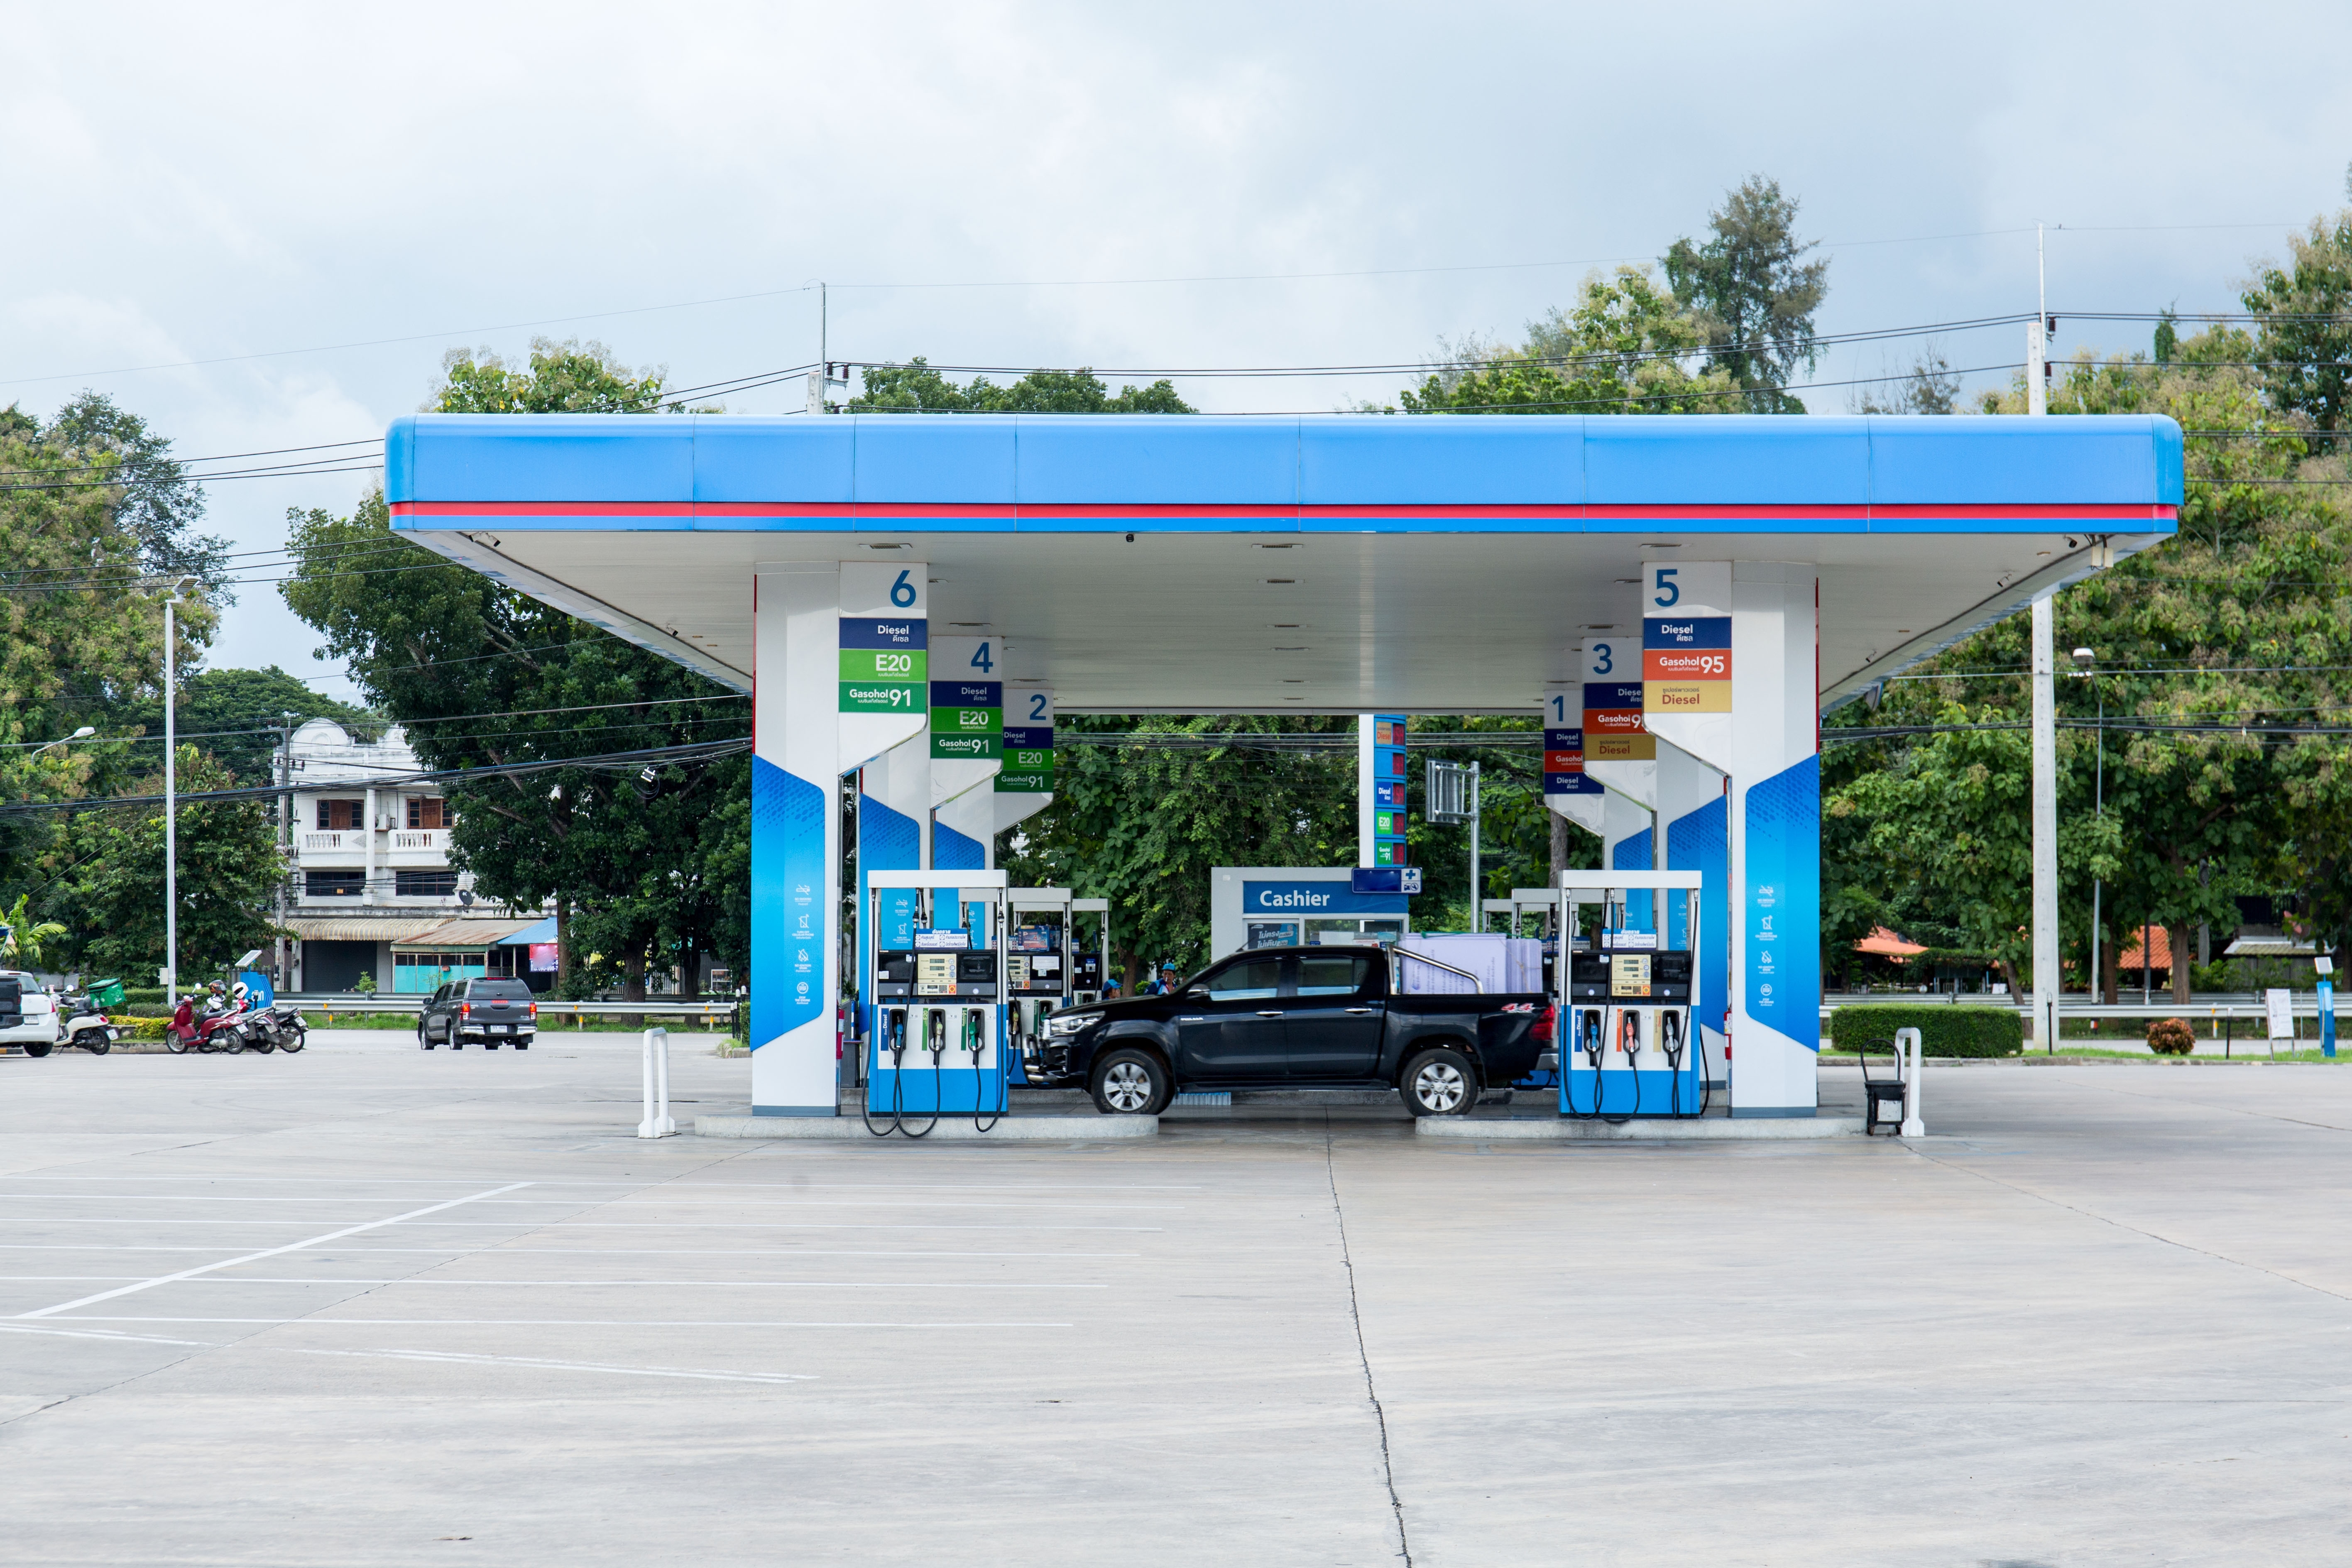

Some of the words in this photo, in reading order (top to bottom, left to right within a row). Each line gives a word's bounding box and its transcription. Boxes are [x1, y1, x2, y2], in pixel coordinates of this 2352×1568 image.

[890, 570, 917, 608] 6
[1654, 569, 1679, 607] 5
[878, 625, 909, 634] Diesel
[1662, 624, 1693, 634] Diesel
[876, 654, 911, 672] E20
[970, 642, 993, 673] 4
[1593, 643, 1613, 675] 3
[1659, 656, 1699, 666] Gasohol
[1701, 656, 1724, 673] 95
[849, 689, 888, 698] Gasohol
[889, 689, 910, 707] 91
[1662, 694, 1699, 704] Diesel
[1029, 694, 1047, 721] 2
[1552, 695, 1564, 722] 1
[959, 711, 989, 725] E20
[1598, 714, 1630, 722] Gasohol
[1631, 714, 1642, 729] 9
[1377, 731, 1391, 740] Diesel
[972, 739, 989, 753] 91
[1600, 745, 1630, 754] Diesel
[1018, 752, 1043, 764] E20
[1028, 775, 1043, 788] 91
[1379, 817, 1390, 827] E20
[1260, 890, 1330, 907] Cashier
